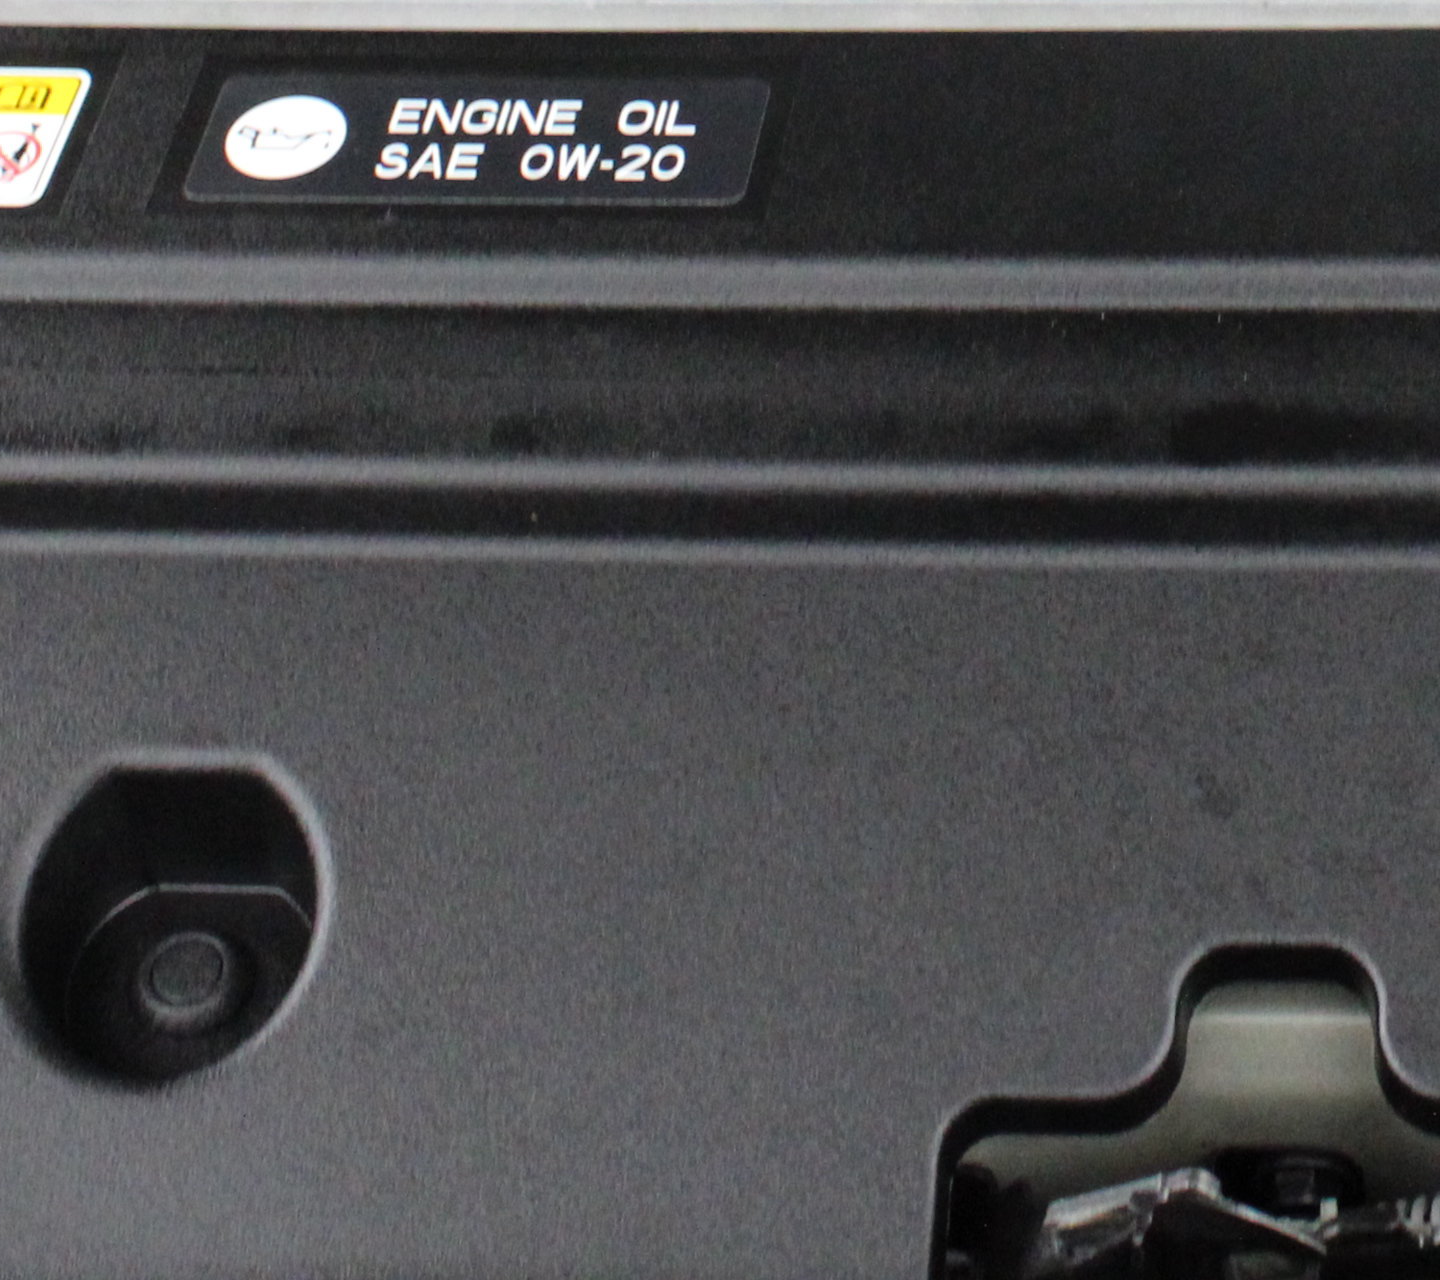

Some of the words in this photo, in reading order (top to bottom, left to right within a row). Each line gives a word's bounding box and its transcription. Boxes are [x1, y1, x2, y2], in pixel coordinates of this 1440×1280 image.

[387, 98, 582, 136] ENGINE
[616, 100, 697, 137] OIL
[374, 142, 485, 181] SAE
[519, 144, 687, 182] 0W-20
